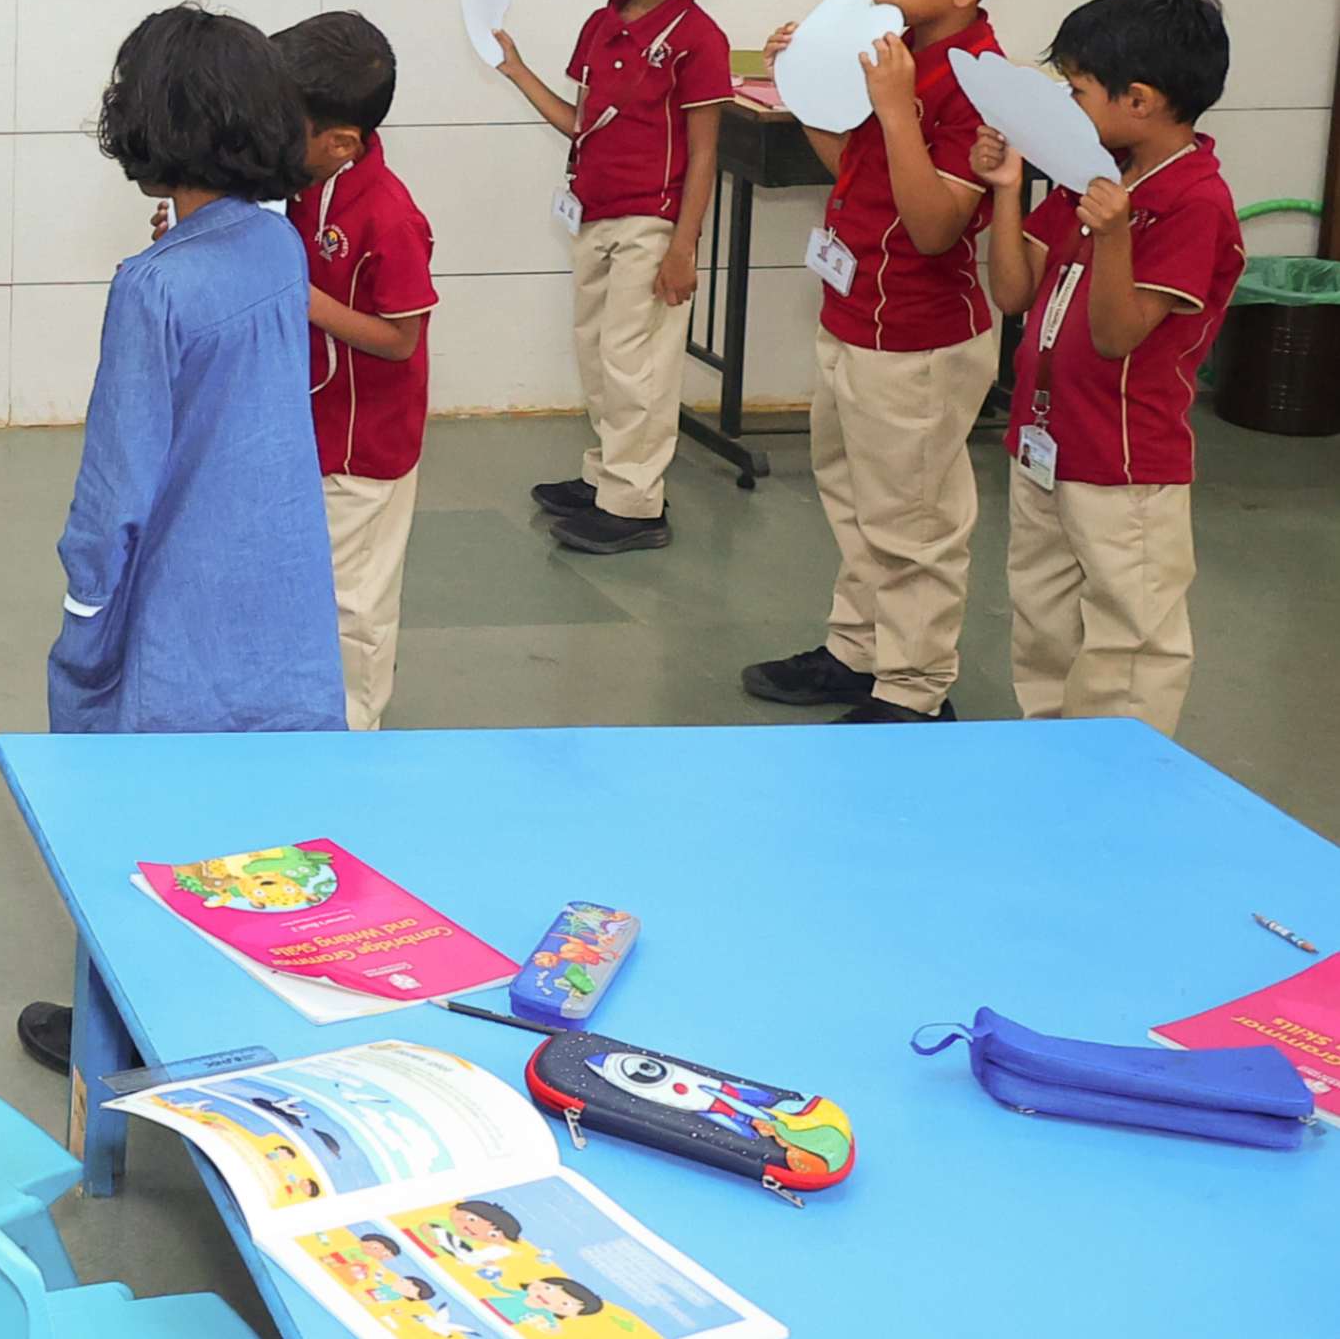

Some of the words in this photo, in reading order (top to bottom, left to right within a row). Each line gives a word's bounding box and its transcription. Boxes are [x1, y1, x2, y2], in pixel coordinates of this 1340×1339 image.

[379, 917, 418, 933] and
[312, 926, 385, 949] Writing
[357, 925, 454, 955] Cambridge
[268, 941, 318, 958] Skills
[1271, 1016, 1335, 1047] Skills
